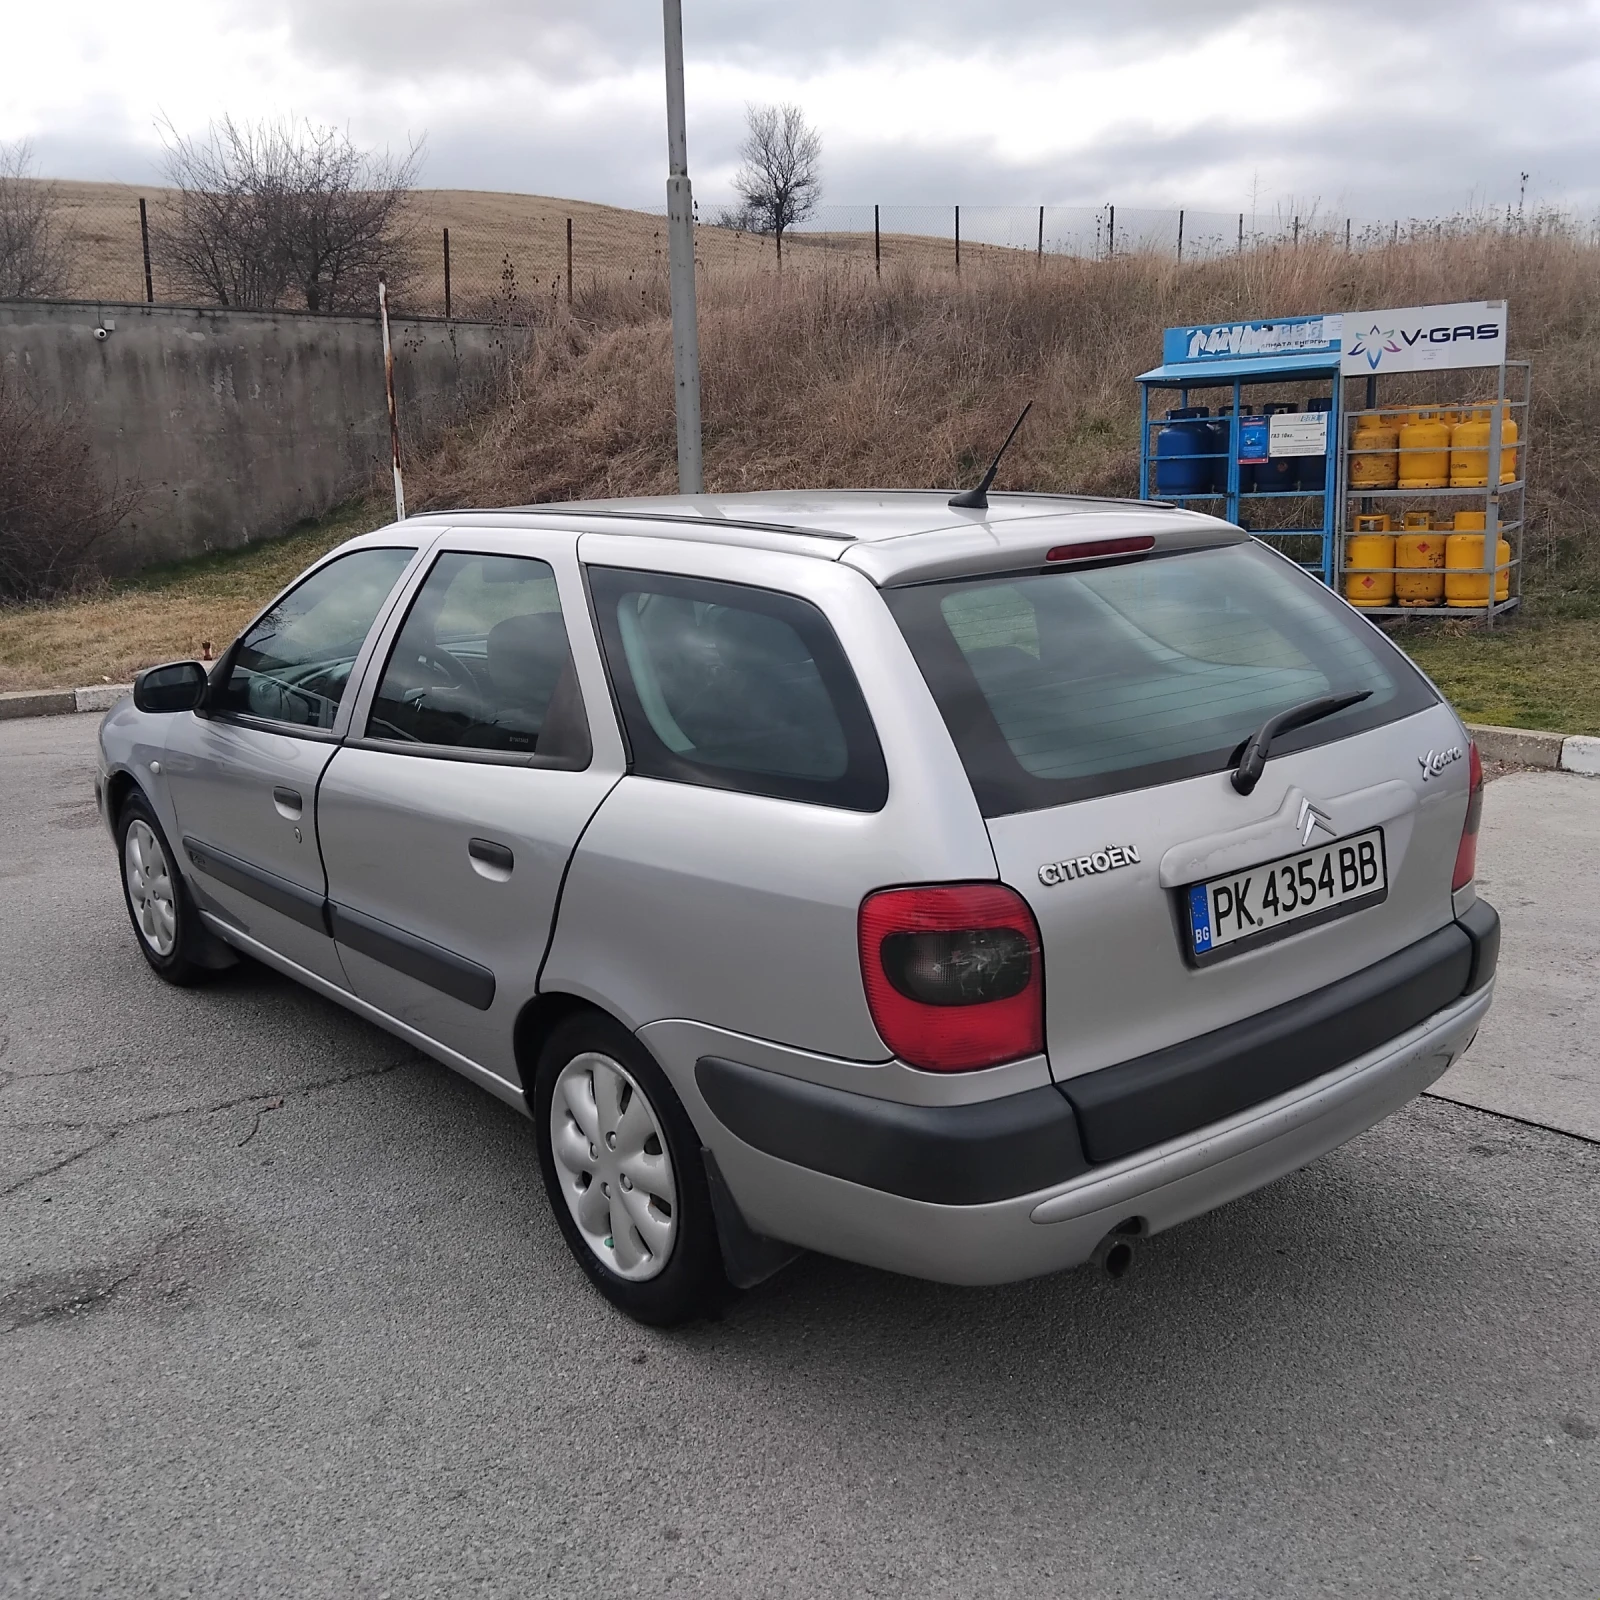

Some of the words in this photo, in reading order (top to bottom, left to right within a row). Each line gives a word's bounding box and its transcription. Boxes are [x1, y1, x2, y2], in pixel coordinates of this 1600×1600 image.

[1400, 323, 1499, 347] V-GAS
[1038, 843, 1141, 887] CITROËN
[1212, 877, 1256, 937] PK
[1262, 852, 1335, 917] 4354
[1338, 840, 1378, 893] BB
[1195, 927, 1210, 944] BG
